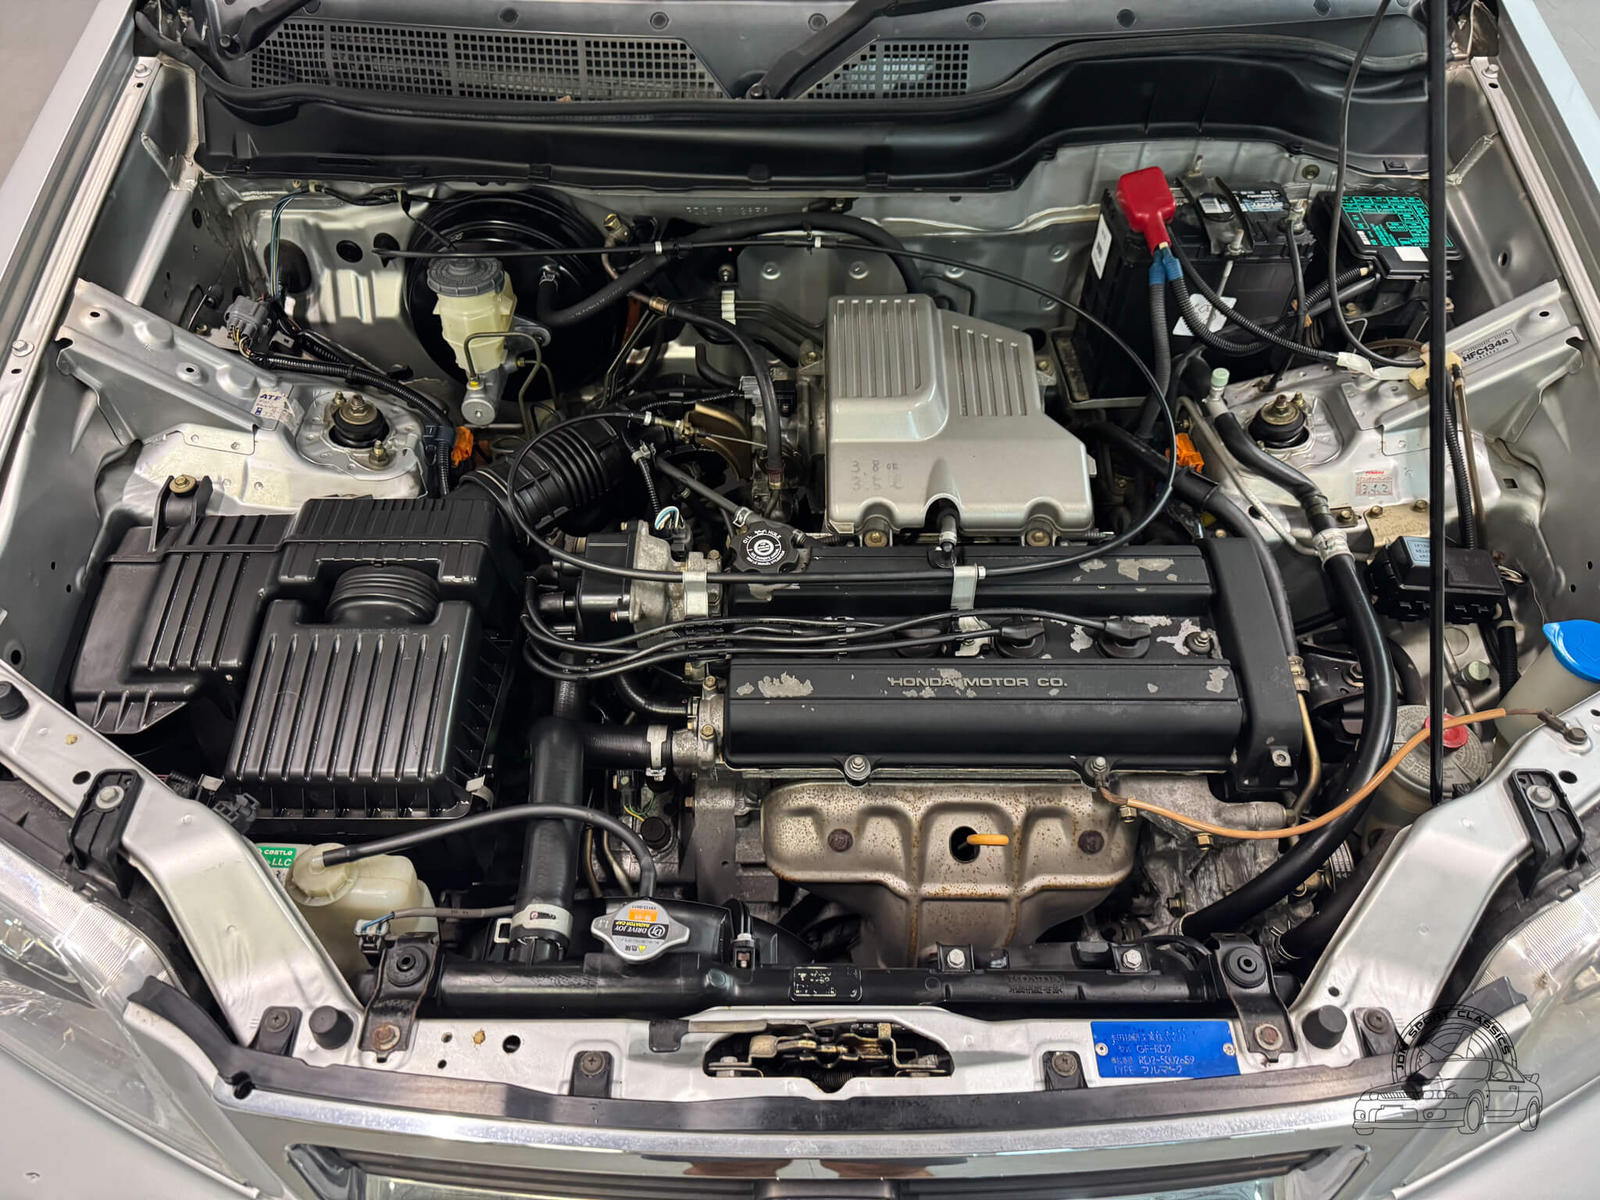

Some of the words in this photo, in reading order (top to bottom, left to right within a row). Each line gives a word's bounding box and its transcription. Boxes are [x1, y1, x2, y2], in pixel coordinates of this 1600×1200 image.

[1462, 338, 1509, 362] HFC134a
[889, 677, 953, 687] HONDA
[964, 677, 1029, 687] MOTOR
[1037, 677, 1068, 687] CO.
[272, 857, 292, 867] LLC
